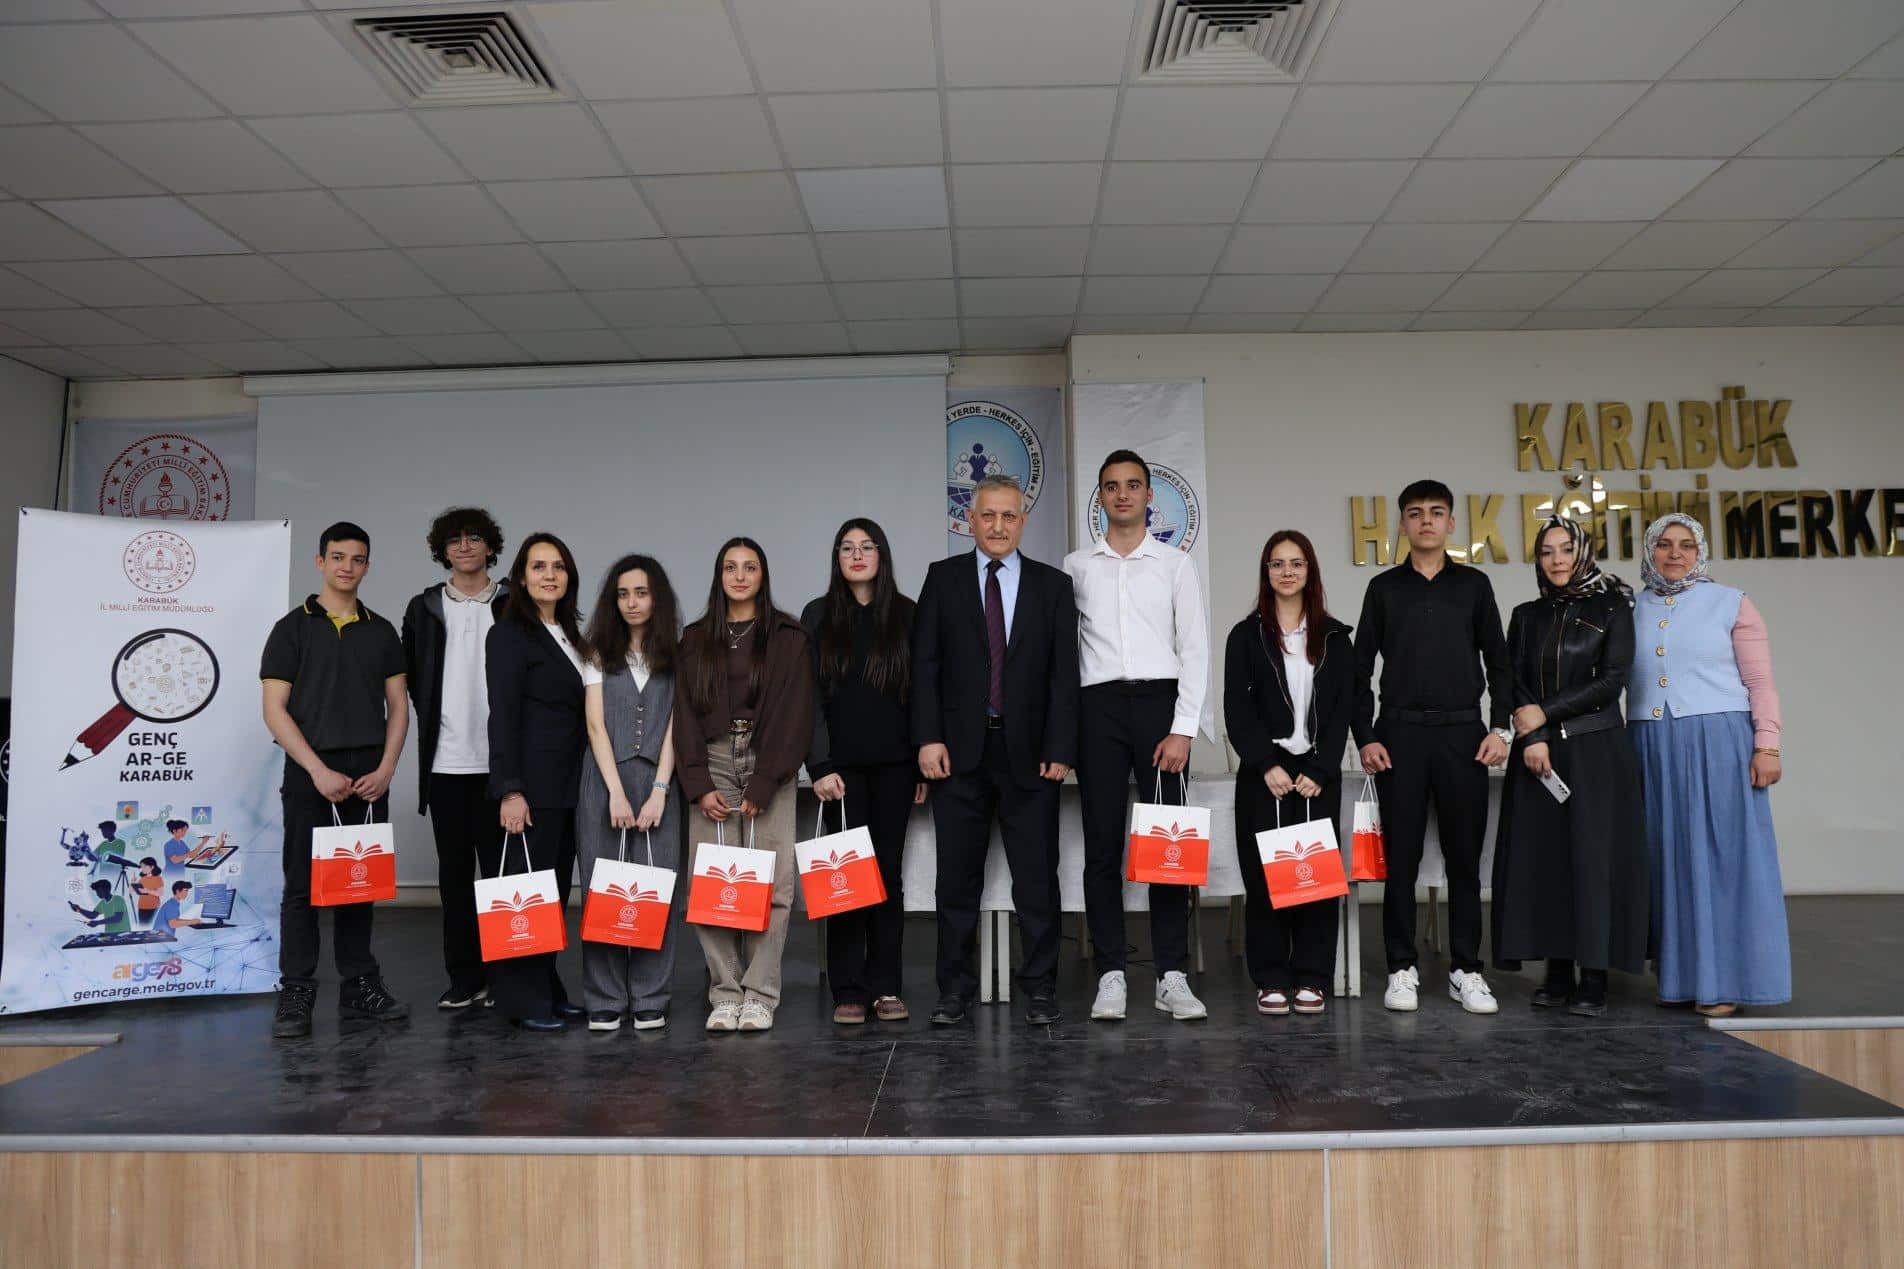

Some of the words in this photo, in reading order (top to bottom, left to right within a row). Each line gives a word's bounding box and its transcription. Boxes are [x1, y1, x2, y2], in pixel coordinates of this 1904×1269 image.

[951, 406, 981, 419] YERDE
[988, 408, 1021, 430] HERKES
[1514, 386, 1798, 471] KARABÜK
[1153, 468, 1180, 486] HERKES
[1351, 494, 1509, 565] HK
[1720, 489, 1904, 560] MERKE
[128, 732, 178, 749] GENÇ
[126, 752, 187, 766] AR-GE
[120, 767, 193, 782] KARABÜK
[73, 979, 216, 1002] gencarge.meb.gov.tr
